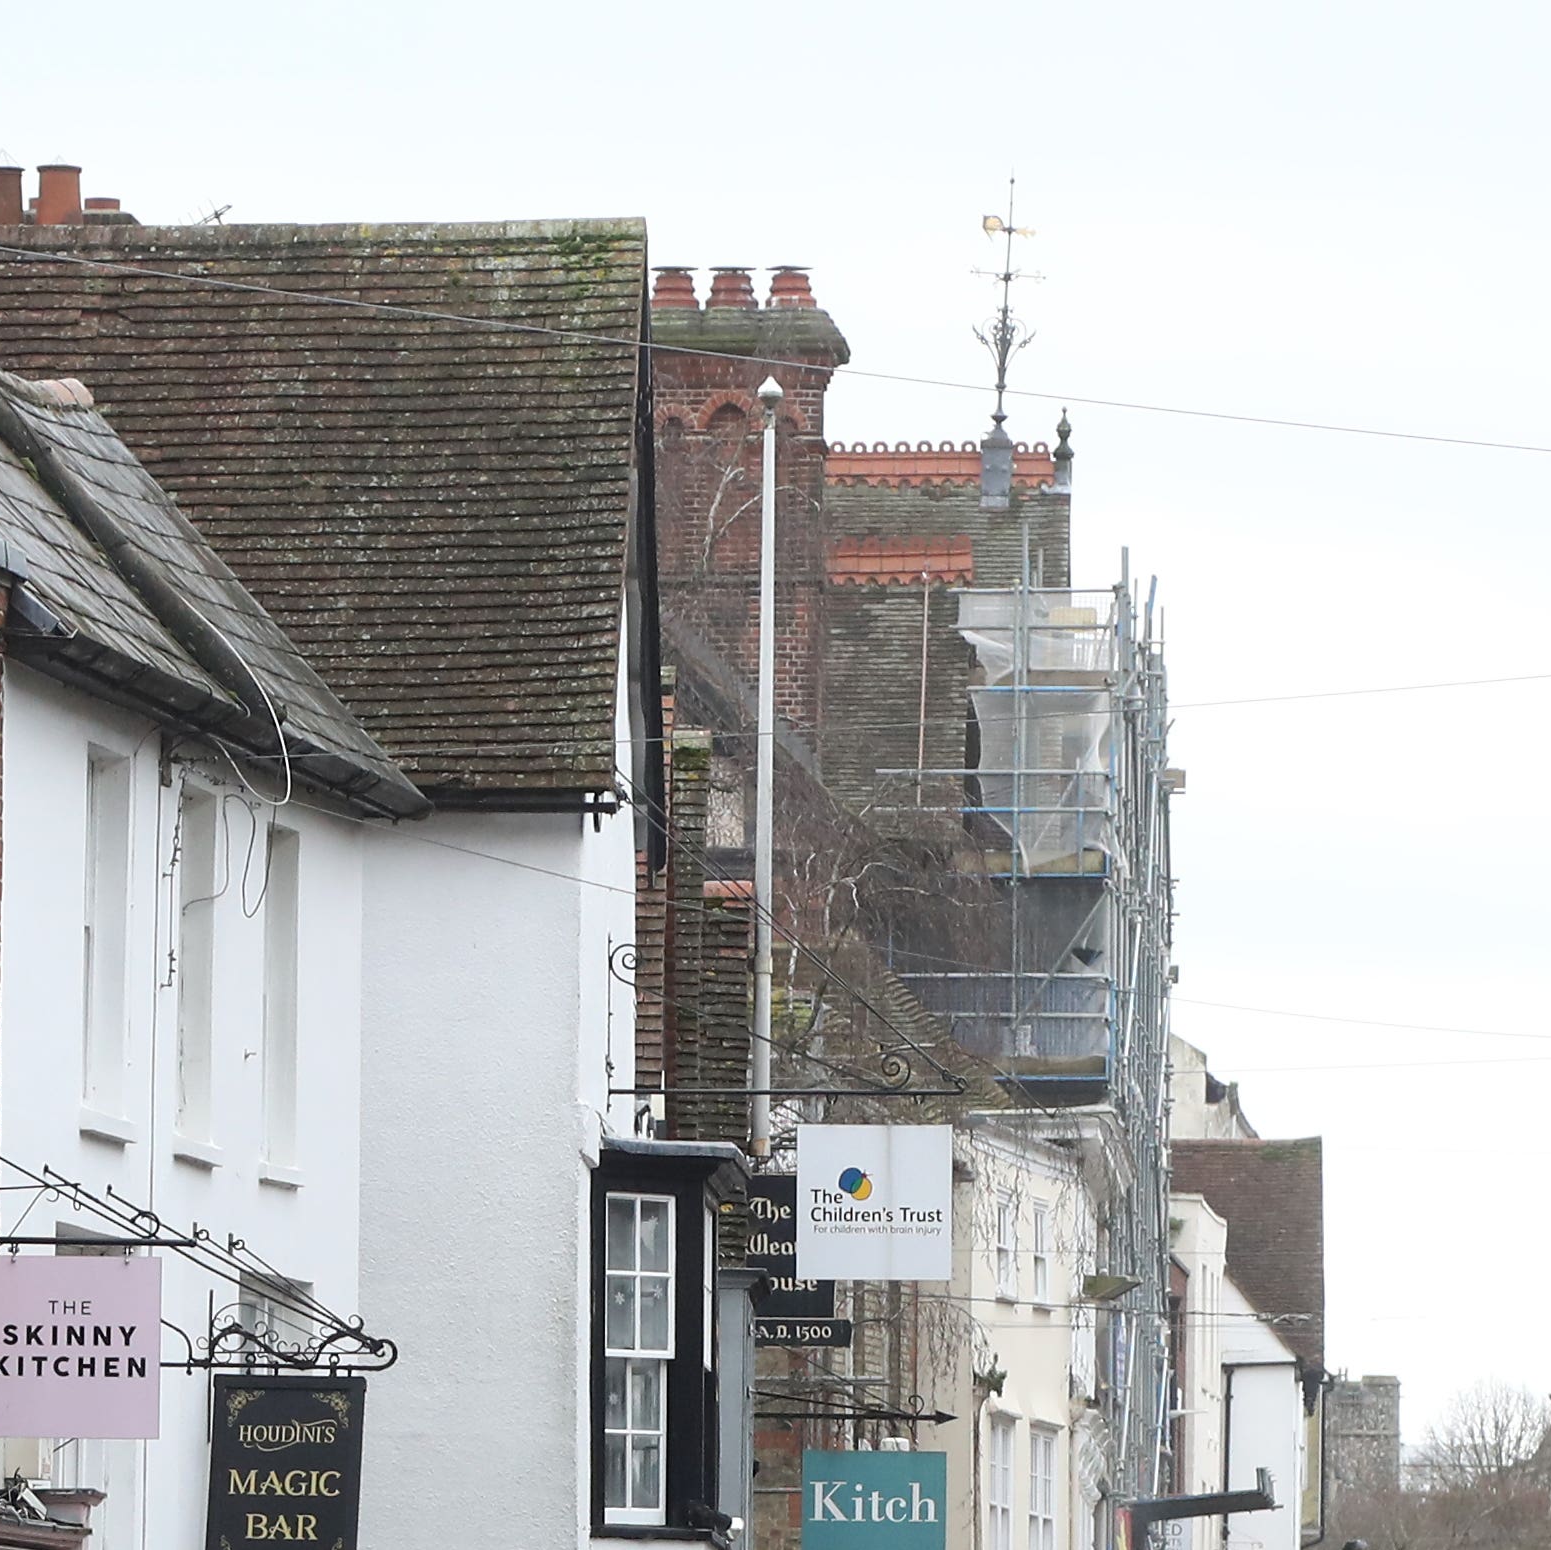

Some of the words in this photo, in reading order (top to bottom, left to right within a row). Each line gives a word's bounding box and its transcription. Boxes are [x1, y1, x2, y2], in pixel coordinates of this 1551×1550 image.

[810, 1189, 843, 1204] The
[750, 1197, 792, 1223] The
[811, 1207, 893, 1222] Children's
[900, 1207, 943, 1223] Trust
[813, 1226, 828, 1234] For
[830, 1225, 865, 1234] children
[868, 1225, 888, 1234] with
[890, 1225, 913, 1234] brain
[915, 1225, 941, 1236] injury
[770, 1277, 818, 1292] ouse
[48, 1300, 92, 1315] THE
[3, 1324, 137, 1346] SKINNY
[239, 1420, 337, 1450] HOUDINI'S
[228, 1469, 341, 1497] MAGIC
[809, 1480, 938, 1523] Kitch
[245, 1513, 318, 1541] BAR
